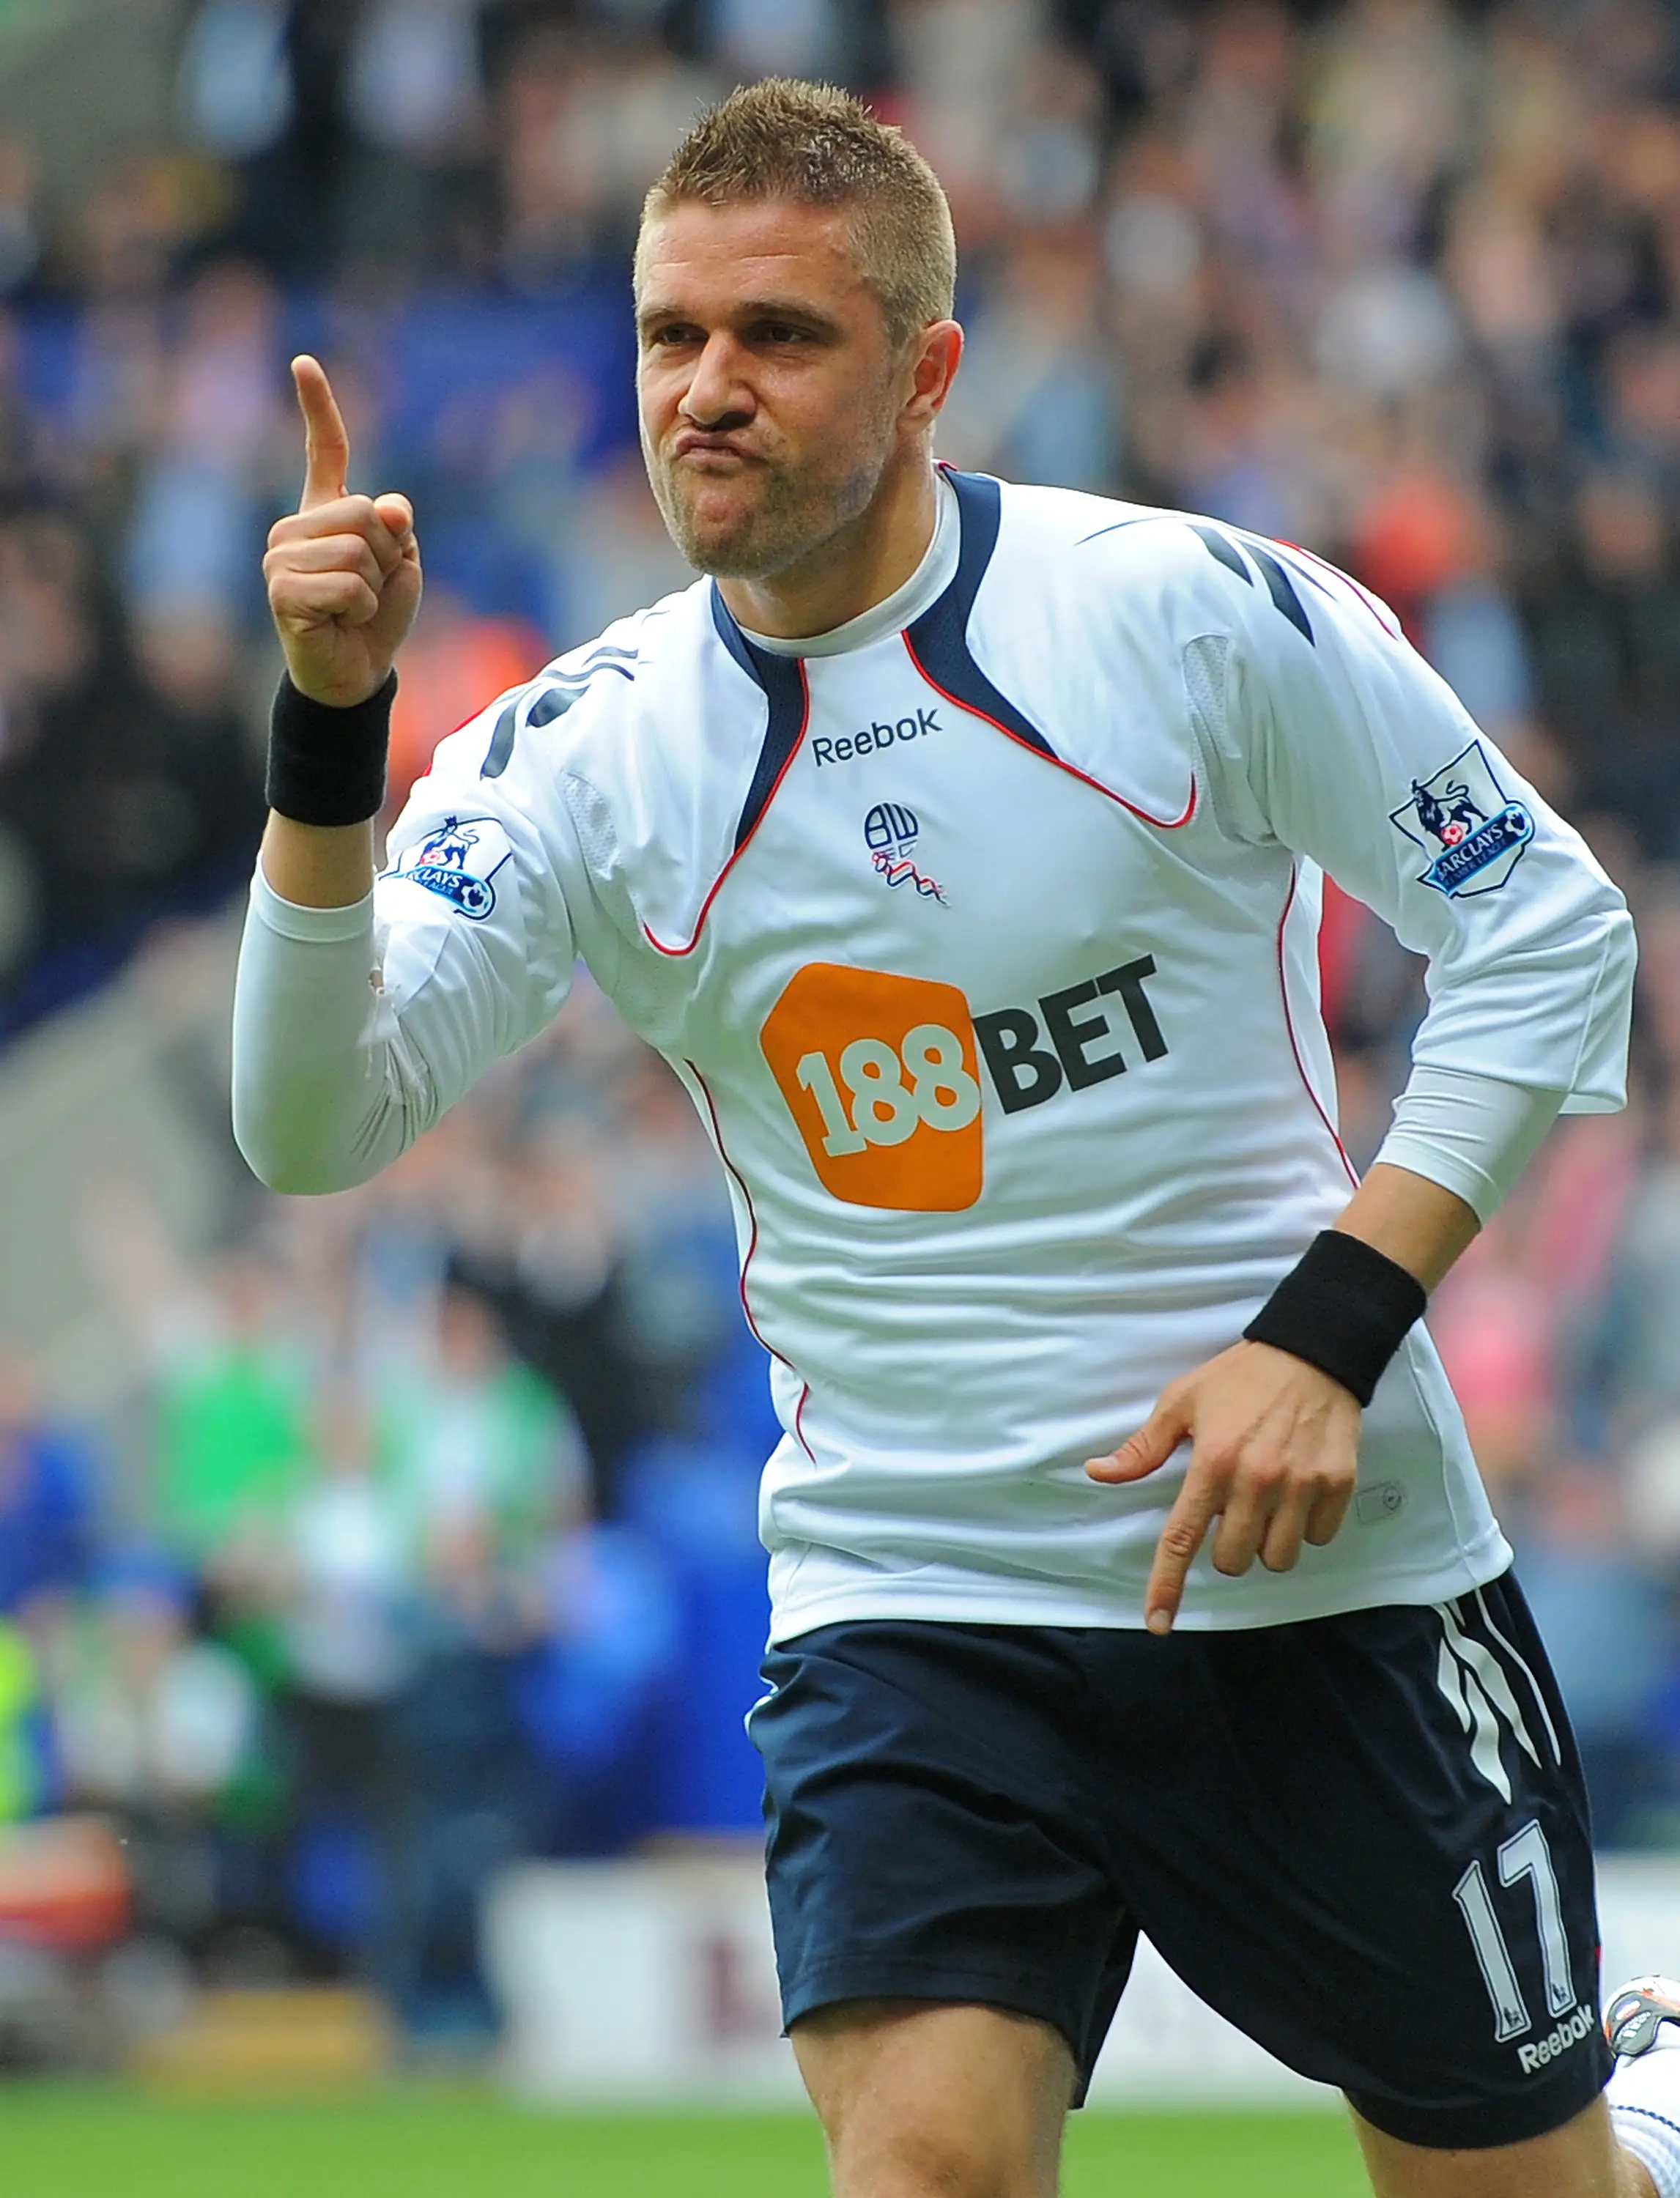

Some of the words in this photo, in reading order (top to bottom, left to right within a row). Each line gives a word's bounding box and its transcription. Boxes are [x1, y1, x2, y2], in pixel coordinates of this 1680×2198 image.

[812, 708, 943, 767] Reebok
[406, 867, 463, 888] CLAYS
[796, 953, 1169, 1158] 188BET
[1451, 1818, 1577, 2043] 17
[1517, 2004, 1595, 2074] Reebok
